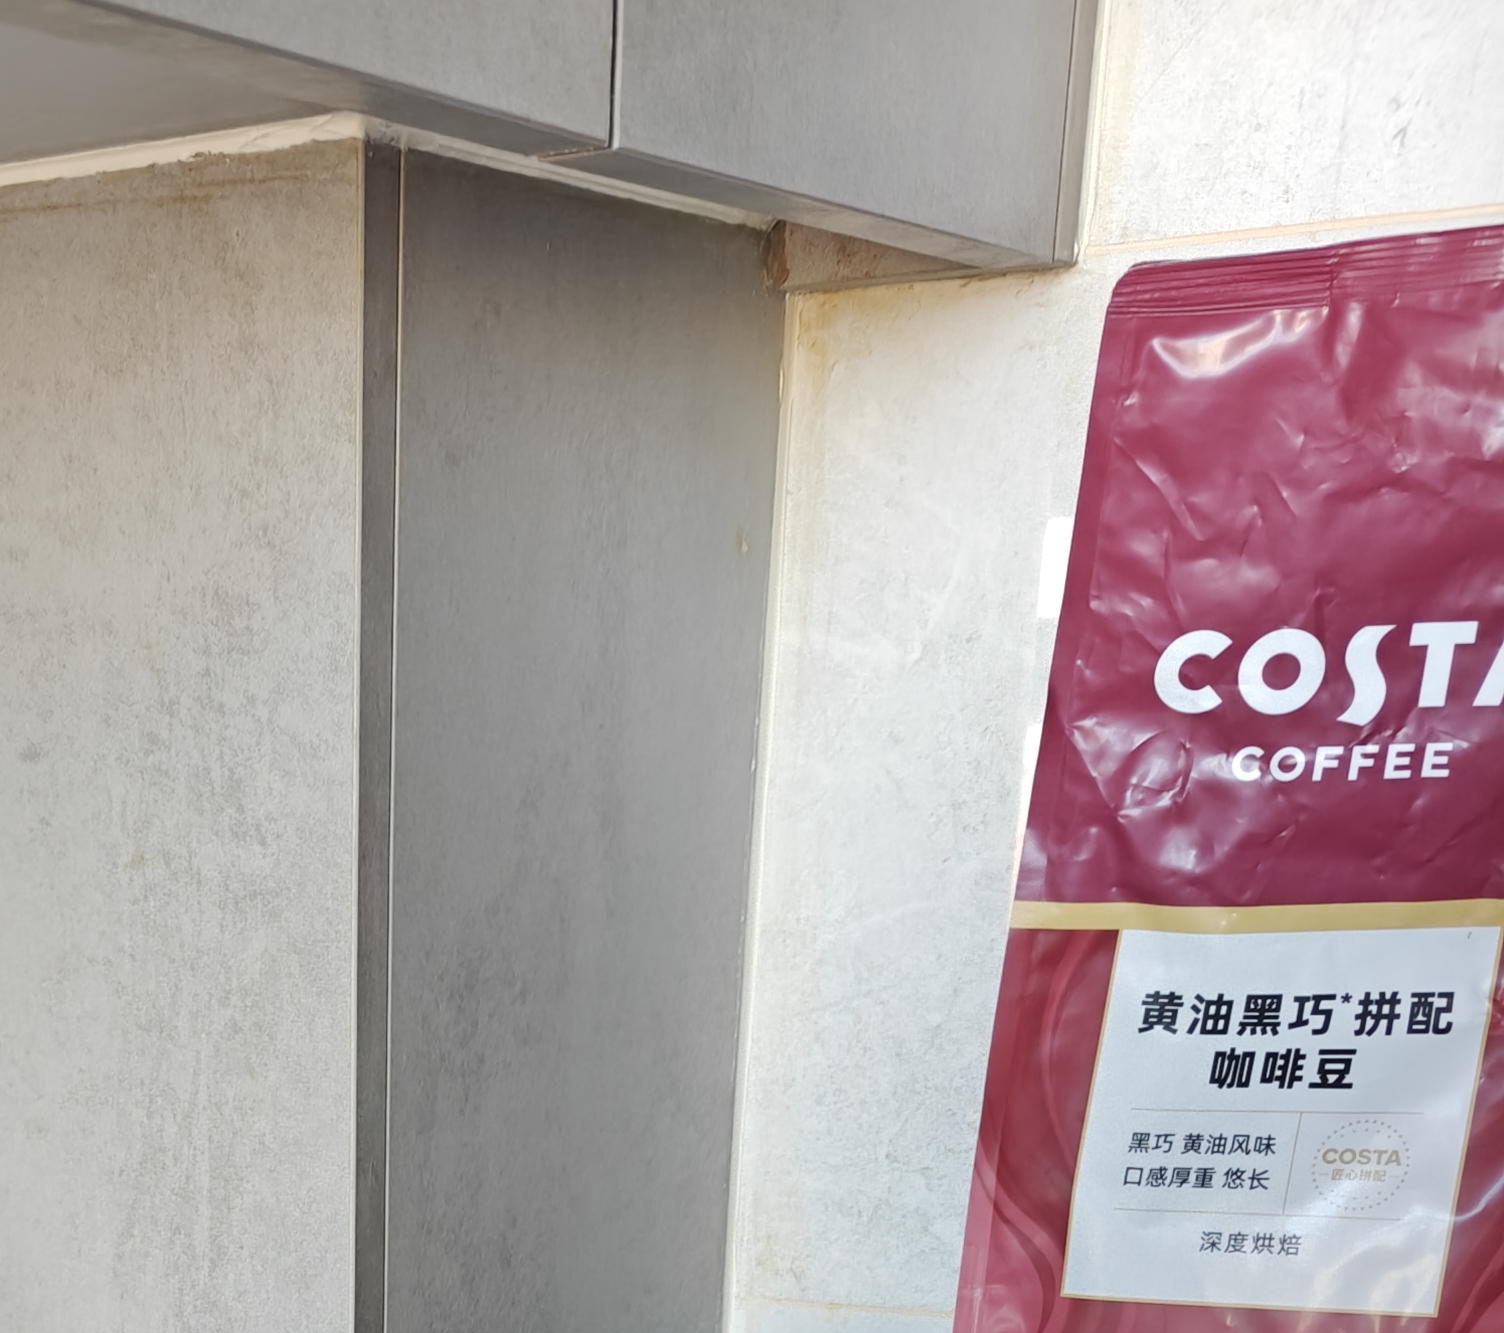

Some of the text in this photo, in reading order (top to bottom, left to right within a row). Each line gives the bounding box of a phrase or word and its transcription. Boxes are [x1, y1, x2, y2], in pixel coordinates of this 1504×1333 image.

[1231, 742, 1454, 782] COFFEE
[1208, 1047, 1358, 1090] 咖啡豆
[1128, 1132, 1277, 1157] 黑巧 黄油风味
[1321, 1147, 1403, 1167] COSTA
[1122, 1166, 1271, 1191] 口感厚重 悠长
[1331, 1168, 1387, 1183] 匠心拼配
[1198, 1230, 1303, 1257] 深度烘焙
